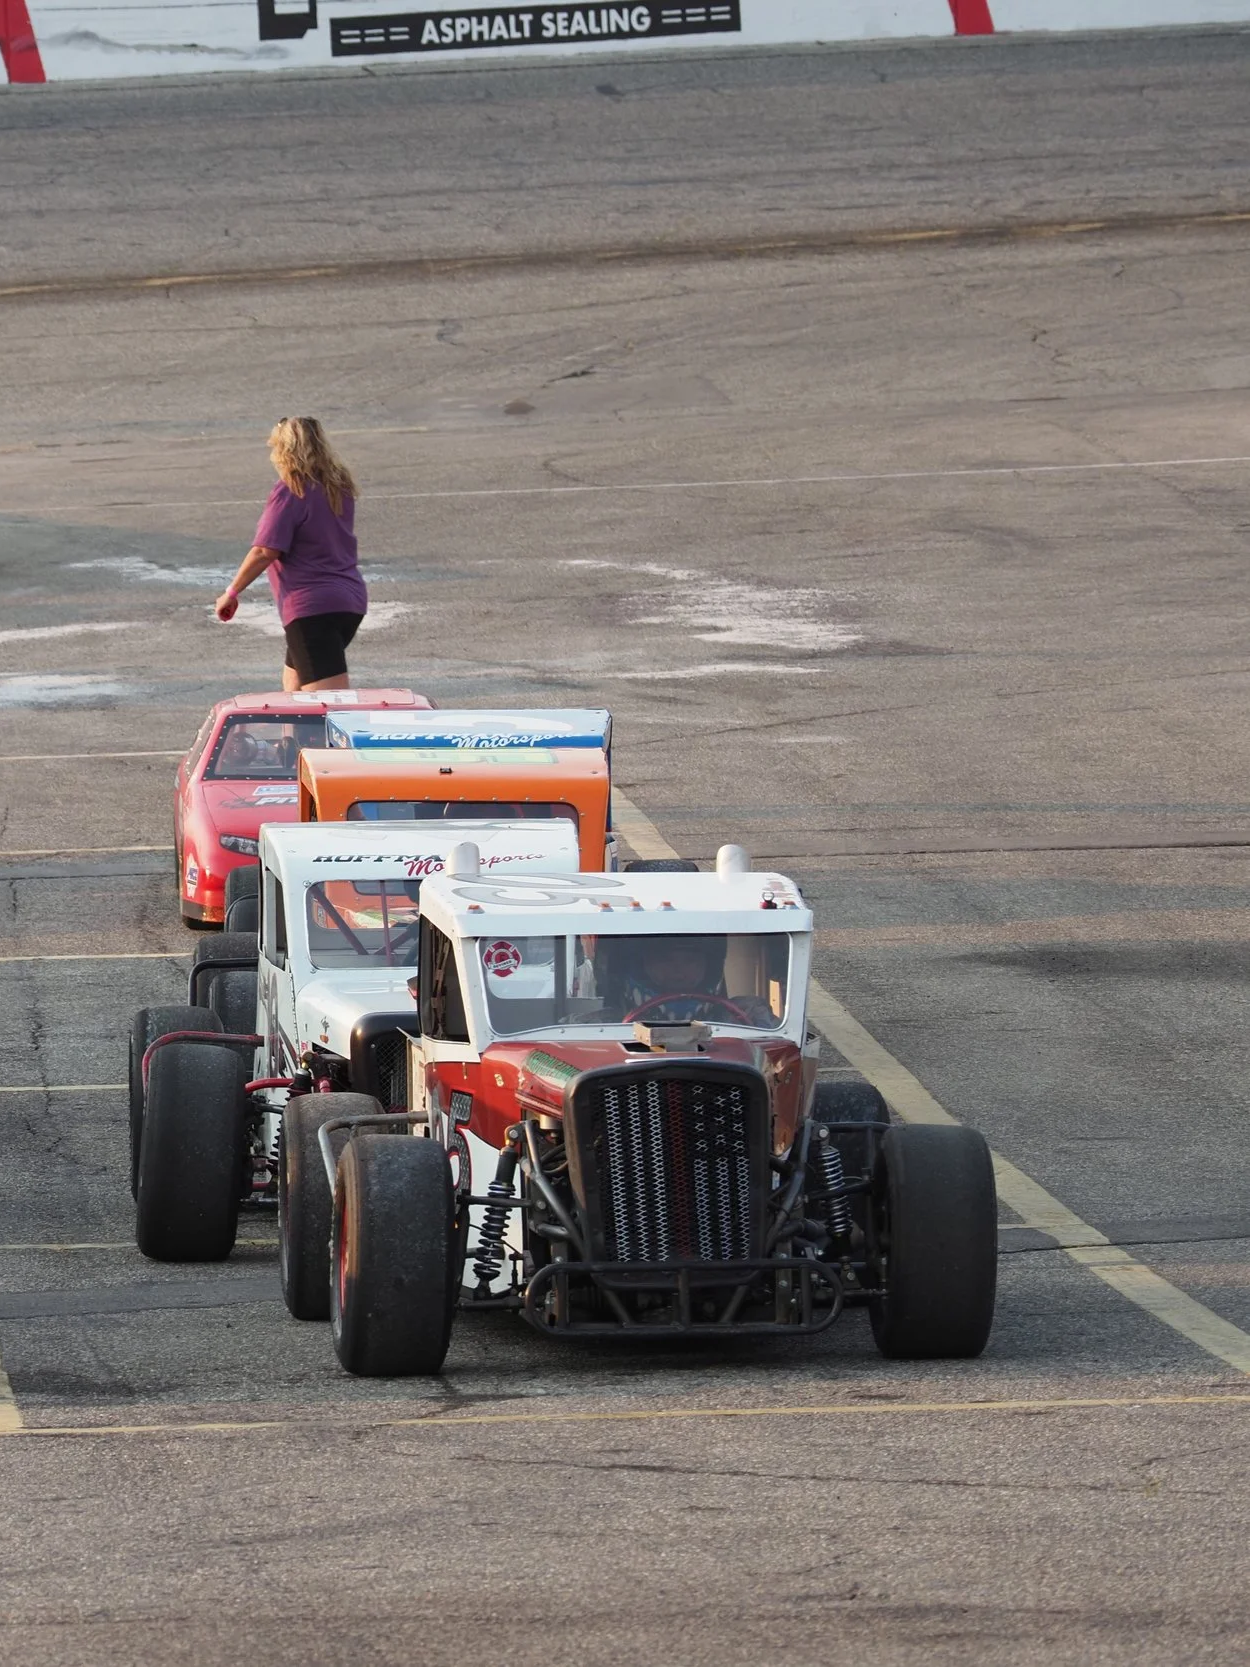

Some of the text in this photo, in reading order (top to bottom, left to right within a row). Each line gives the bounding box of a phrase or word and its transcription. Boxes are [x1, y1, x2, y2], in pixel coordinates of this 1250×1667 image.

[420, 5, 652, 45] ASPHALT SEALING
[312, 853, 547, 877] HOFFMA Mosports
